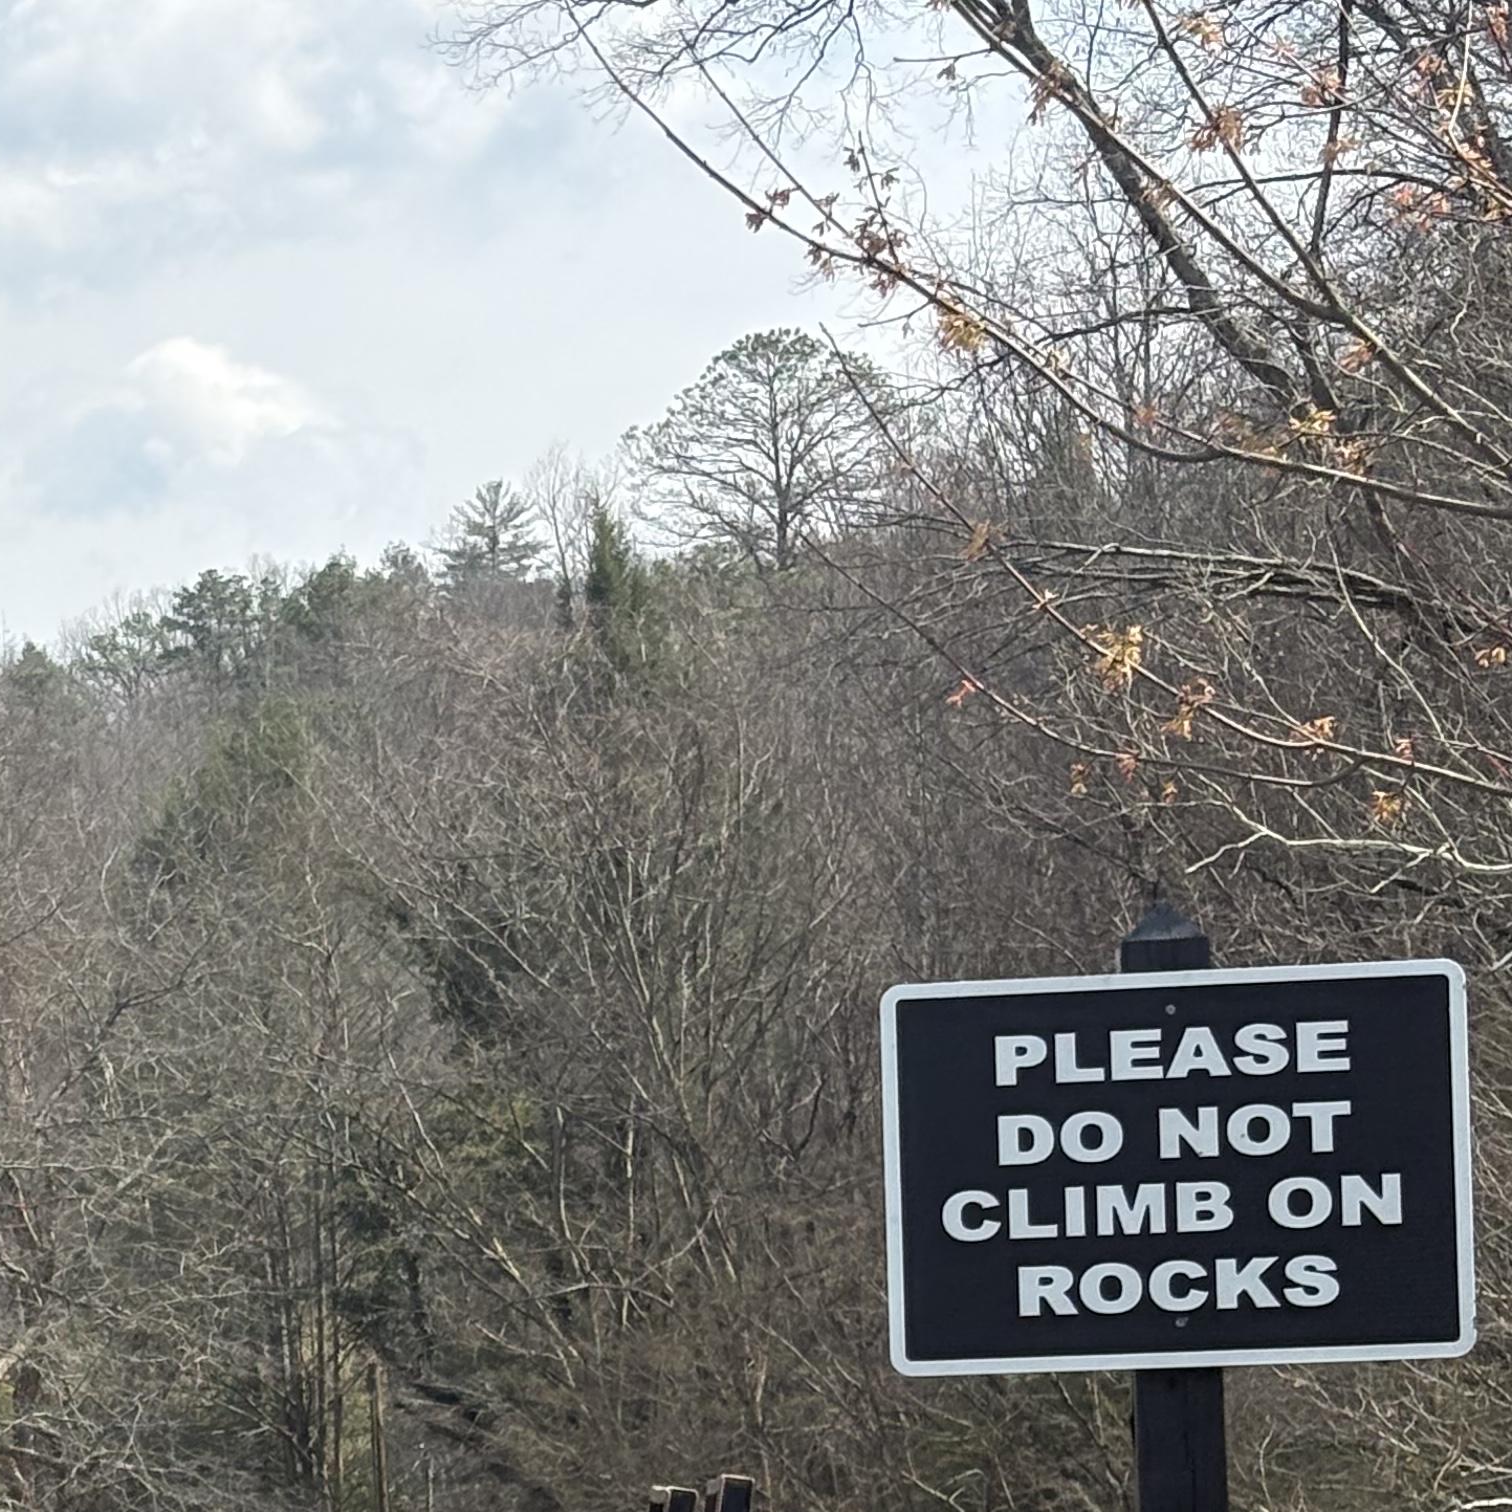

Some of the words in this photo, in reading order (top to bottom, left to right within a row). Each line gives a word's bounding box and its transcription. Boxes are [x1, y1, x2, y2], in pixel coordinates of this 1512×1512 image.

[994, 1020, 1351, 1086] PLEASE
[997, 1111, 1123, 1166] DO
[1158, 1101, 1352, 1159] NOT
[942, 1181, 1234, 1242] CLIMB
[1268, 1173, 1403, 1229] ON
[1018, 1254, 1340, 1317] ROCKS
